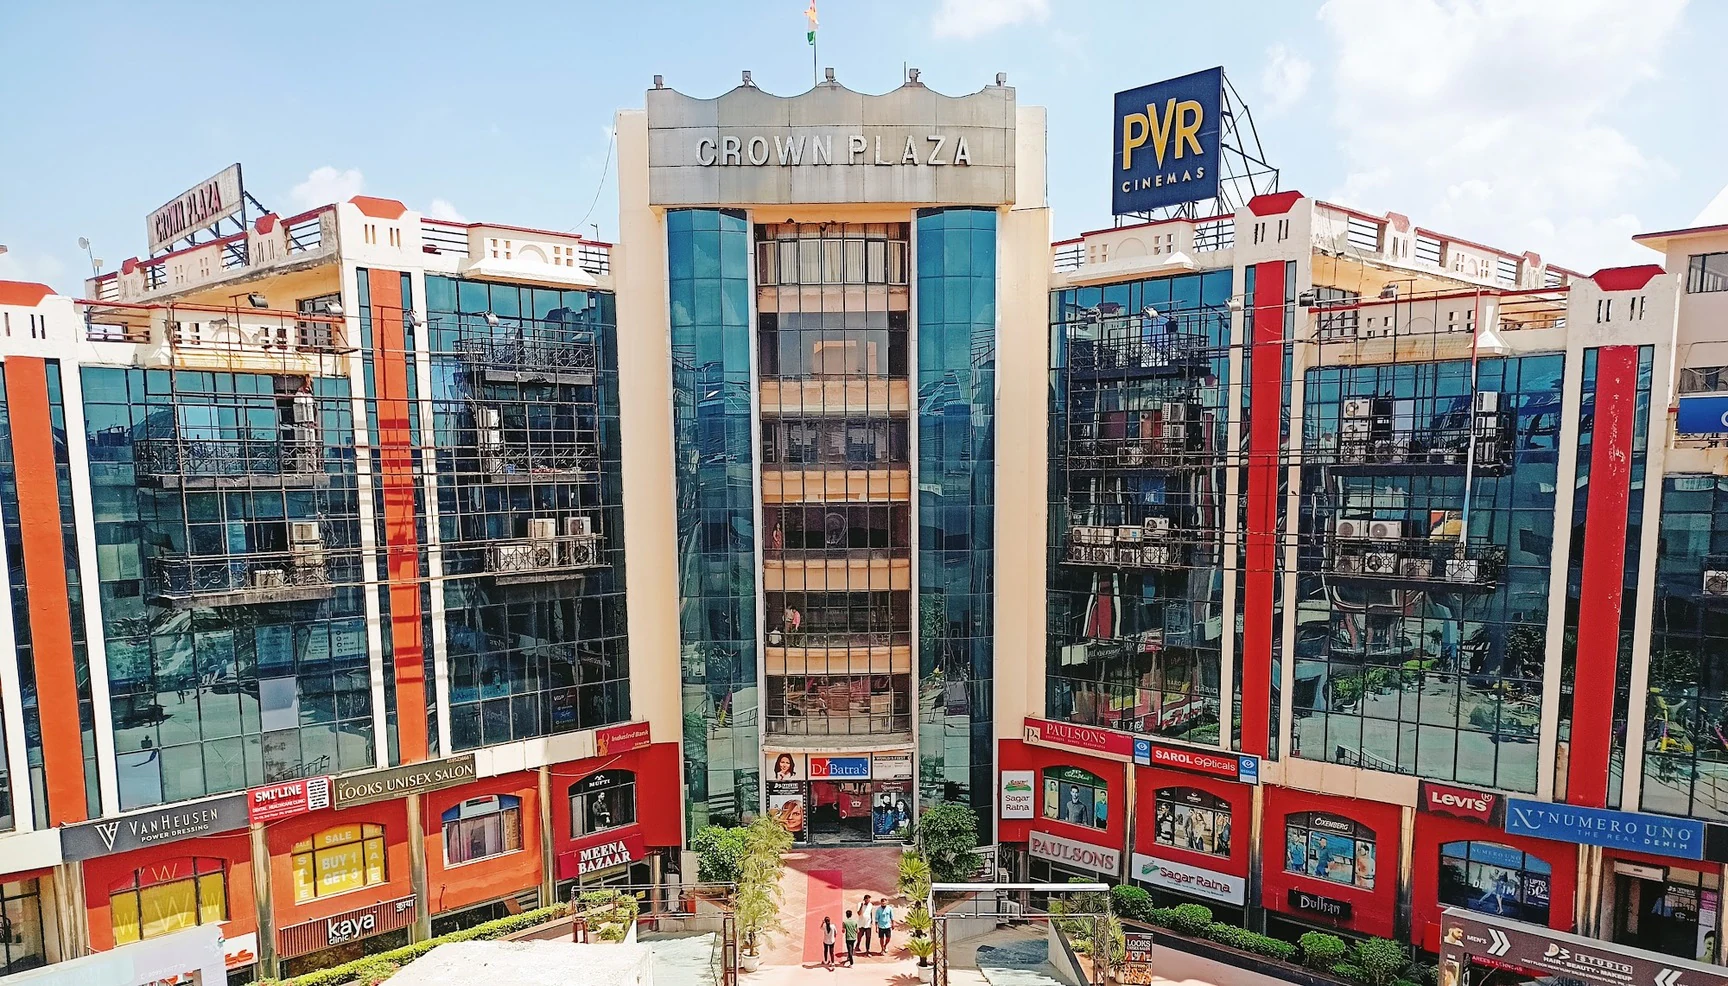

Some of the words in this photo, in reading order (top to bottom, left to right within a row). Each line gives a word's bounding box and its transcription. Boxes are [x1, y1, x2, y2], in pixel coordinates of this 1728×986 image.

[1123, 97, 1204, 170] PVR
[696, 135, 832, 166] CROWN
[848, 135, 972, 166] PLAZA
[1122, 167, 1205, 193] CINEMAS
[155, 200, 186, 243] CROWN
[186, 181, 223, 226] PLAZA
[1046, 723, 1106, 744] PAULSONS
[1155, 750, 1193, 764] SAROL
[811, 764, 827, 775] Dr
[829, 763, 868, 775] Batra's
[339, 782, 383, 800] LOOKS
[387, 772, 432, 791] UNISEX
[435, 763, 473, 781] SALON
[589, 779, 610, 787] MUFTI
[255, 785, 302, 802] SMI'LINE
[1005, 795, 1030, 803] Sagar
[1005, 804, 1030, 812] Ratna
[1315, 818, 1349, 830] OXENBERG
[1548, 812, 1637, 833] NUMERO
[1645, 824, 1691, 841] UNO
[141, 832, 169, 843] POWER
[171, 824, 209, 838] DRESSING
[325, 831, 352, 844] SALE
[1578, 829, 1598, 838] THE
[1607, 833, 1637, 843] REAL
[1644, 838, 1688, 850] DENIM
[580, 840, 628, 862] MEENA
[1032, 837, 1114, 870] PAULSONS
[322, 854, 347, 870] BUY
[351, 852, 357, 863] 1
[577, 851, 632, 875] BAZAAR
[323, 869, 348, 886] GET
[1160, 867, 1195, 883] Sagar
[1196, 875, 1232, 893] Ratna
[1529, 878, 1546, 887] UPTO
[327, 914, 374, 939] kaya
[329, 934, 349, 945] clinic
[1127, 939, 1150, 947] LOOKS
[1466, 935, 1487, 945] MEN'S
[1543, 956, 1561, 965] HAIR
[1566, 962, 1596, 973] BEAUTY
[1600, 969, 1633, 981] MAKEUP
[1579, 955, 1629, 972] STUDIO
